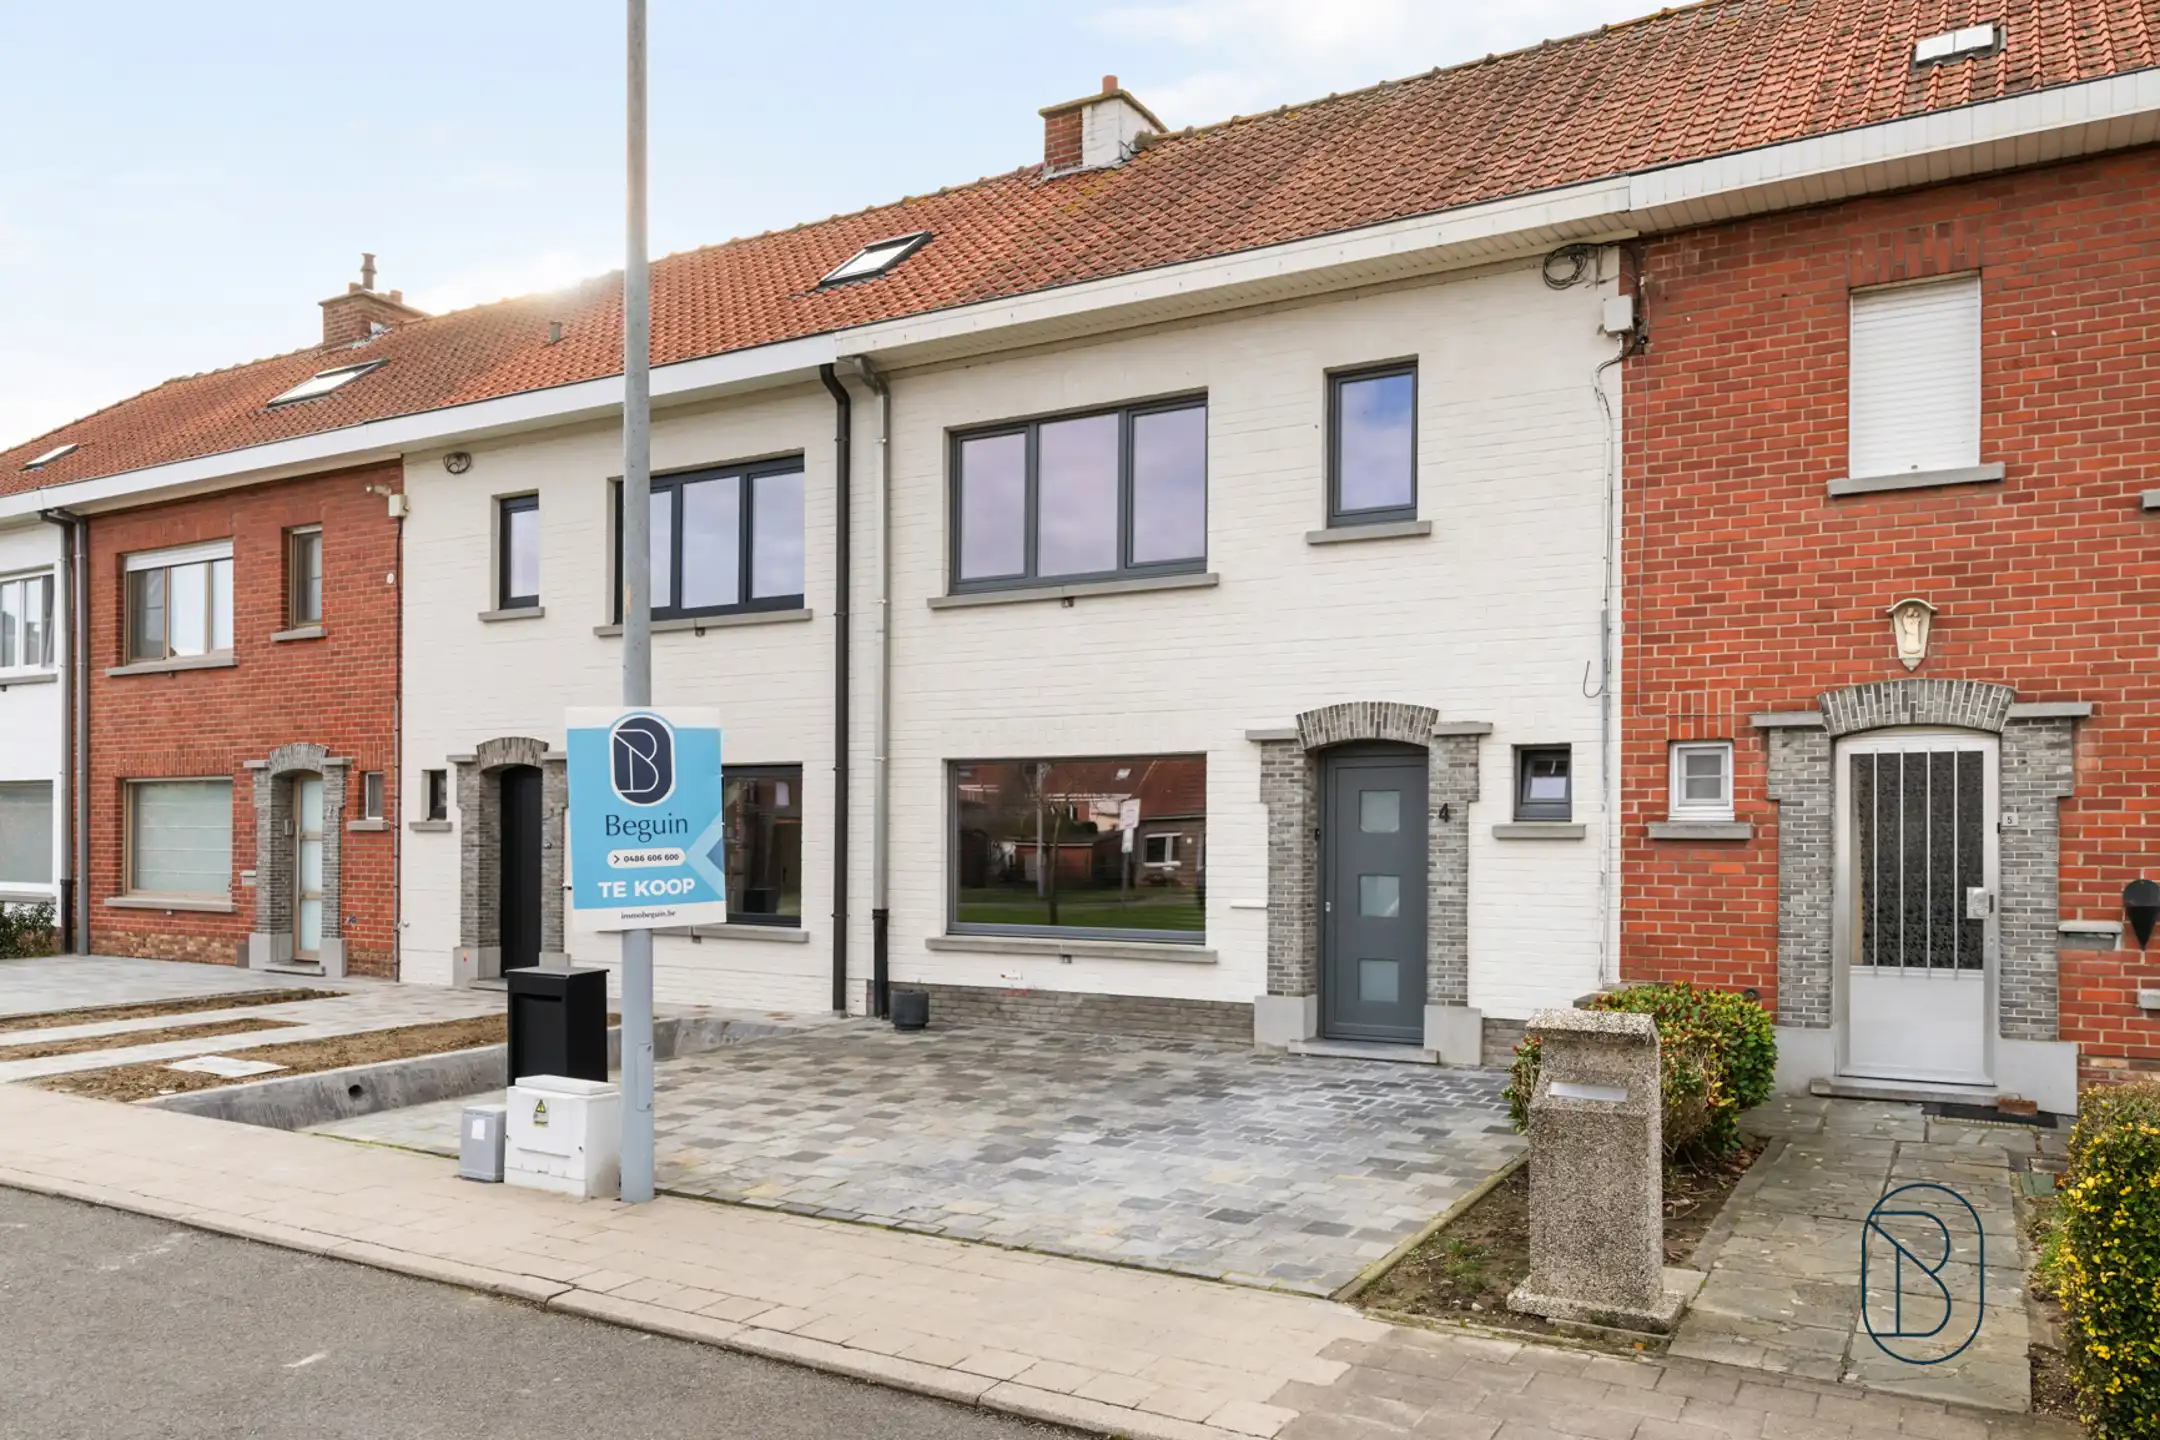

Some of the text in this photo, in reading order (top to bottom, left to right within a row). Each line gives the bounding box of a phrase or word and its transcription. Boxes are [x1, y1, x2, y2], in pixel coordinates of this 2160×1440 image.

[1438, 802, 1450, 823] 4
[2007, 815, 2013, 825] 5
[605, 812, 688, 843] Beguin
[623, 853, 679, 863] 0486 606 600
[597, 878, 696, 898] TE KOOP
[621, 909, 676, 919] immobeguin.be
